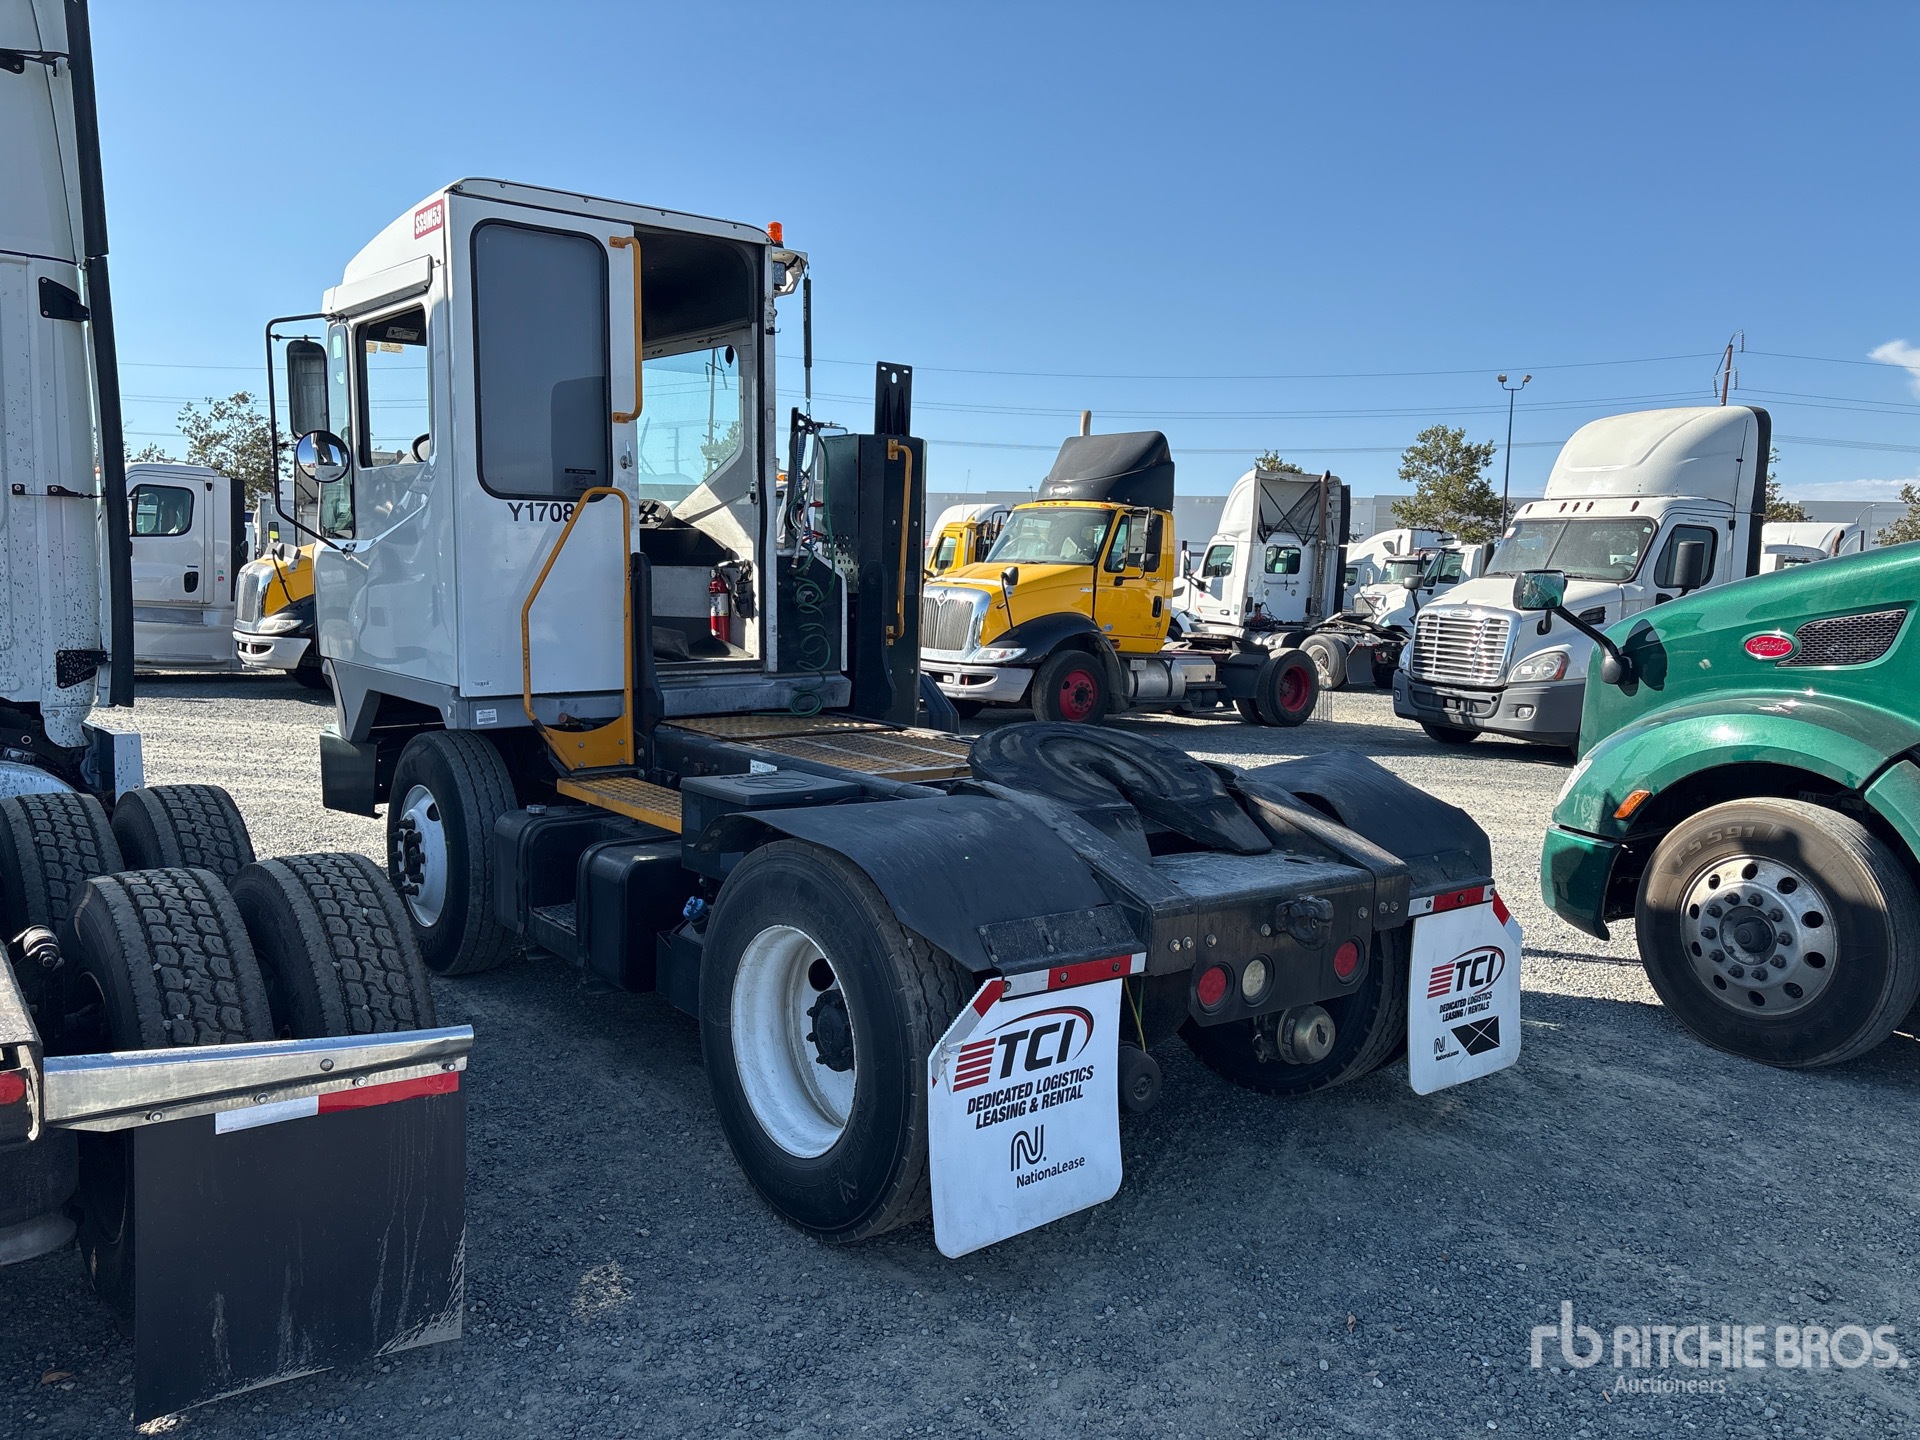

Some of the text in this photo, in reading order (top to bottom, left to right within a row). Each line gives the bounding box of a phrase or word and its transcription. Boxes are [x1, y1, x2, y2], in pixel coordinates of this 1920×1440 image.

[507, 502, 575, 523] Y1708
[1455, 953, 1496, 992] TCI
[1439, 991, 1493, 1014] DEDICATED LOGISTICS
[1442, 1008, 1464, 1022] LEASING
[1468, 1001, 1490, 1015] RENTALS
[998, 1018, 1077, 1080] TCI
[967, 1065, 1094, 1115] DEDICATED LOGISTICS
[975, 1084, 1084, 1130] LEASING & RENTAL
[1016, 1155, 1086, 1189] NationaLease
